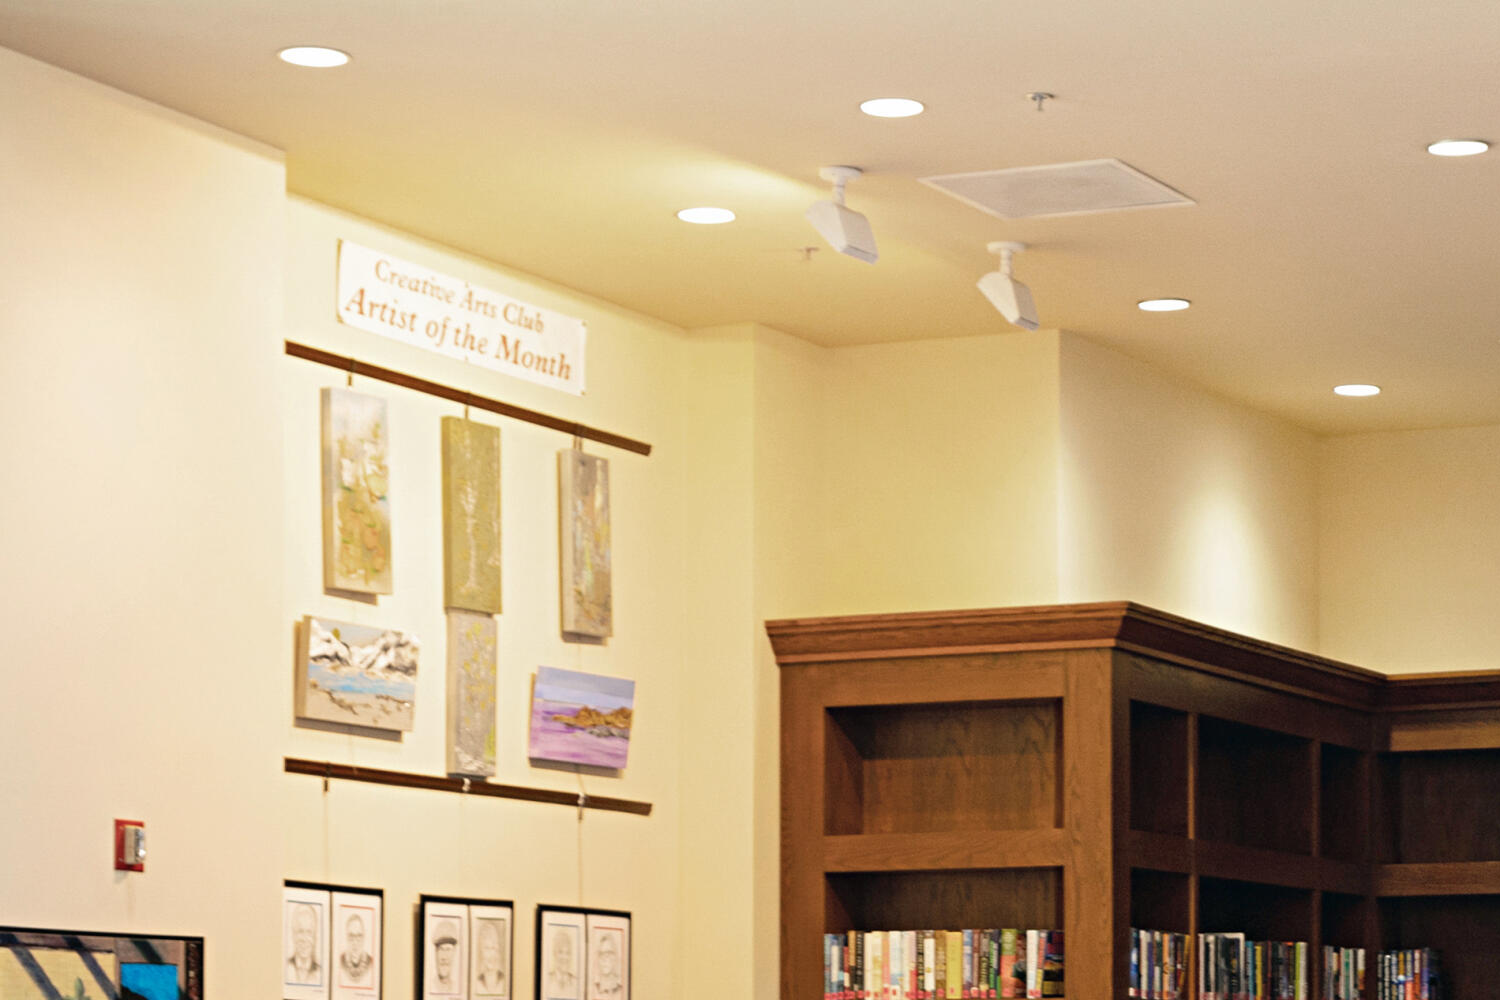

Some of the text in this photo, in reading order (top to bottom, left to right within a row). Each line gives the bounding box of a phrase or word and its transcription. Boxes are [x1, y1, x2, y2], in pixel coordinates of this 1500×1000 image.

[345, 288, 572, 381] Artist of the Month
[375, 258, 545, 334] Creative Arts Club
